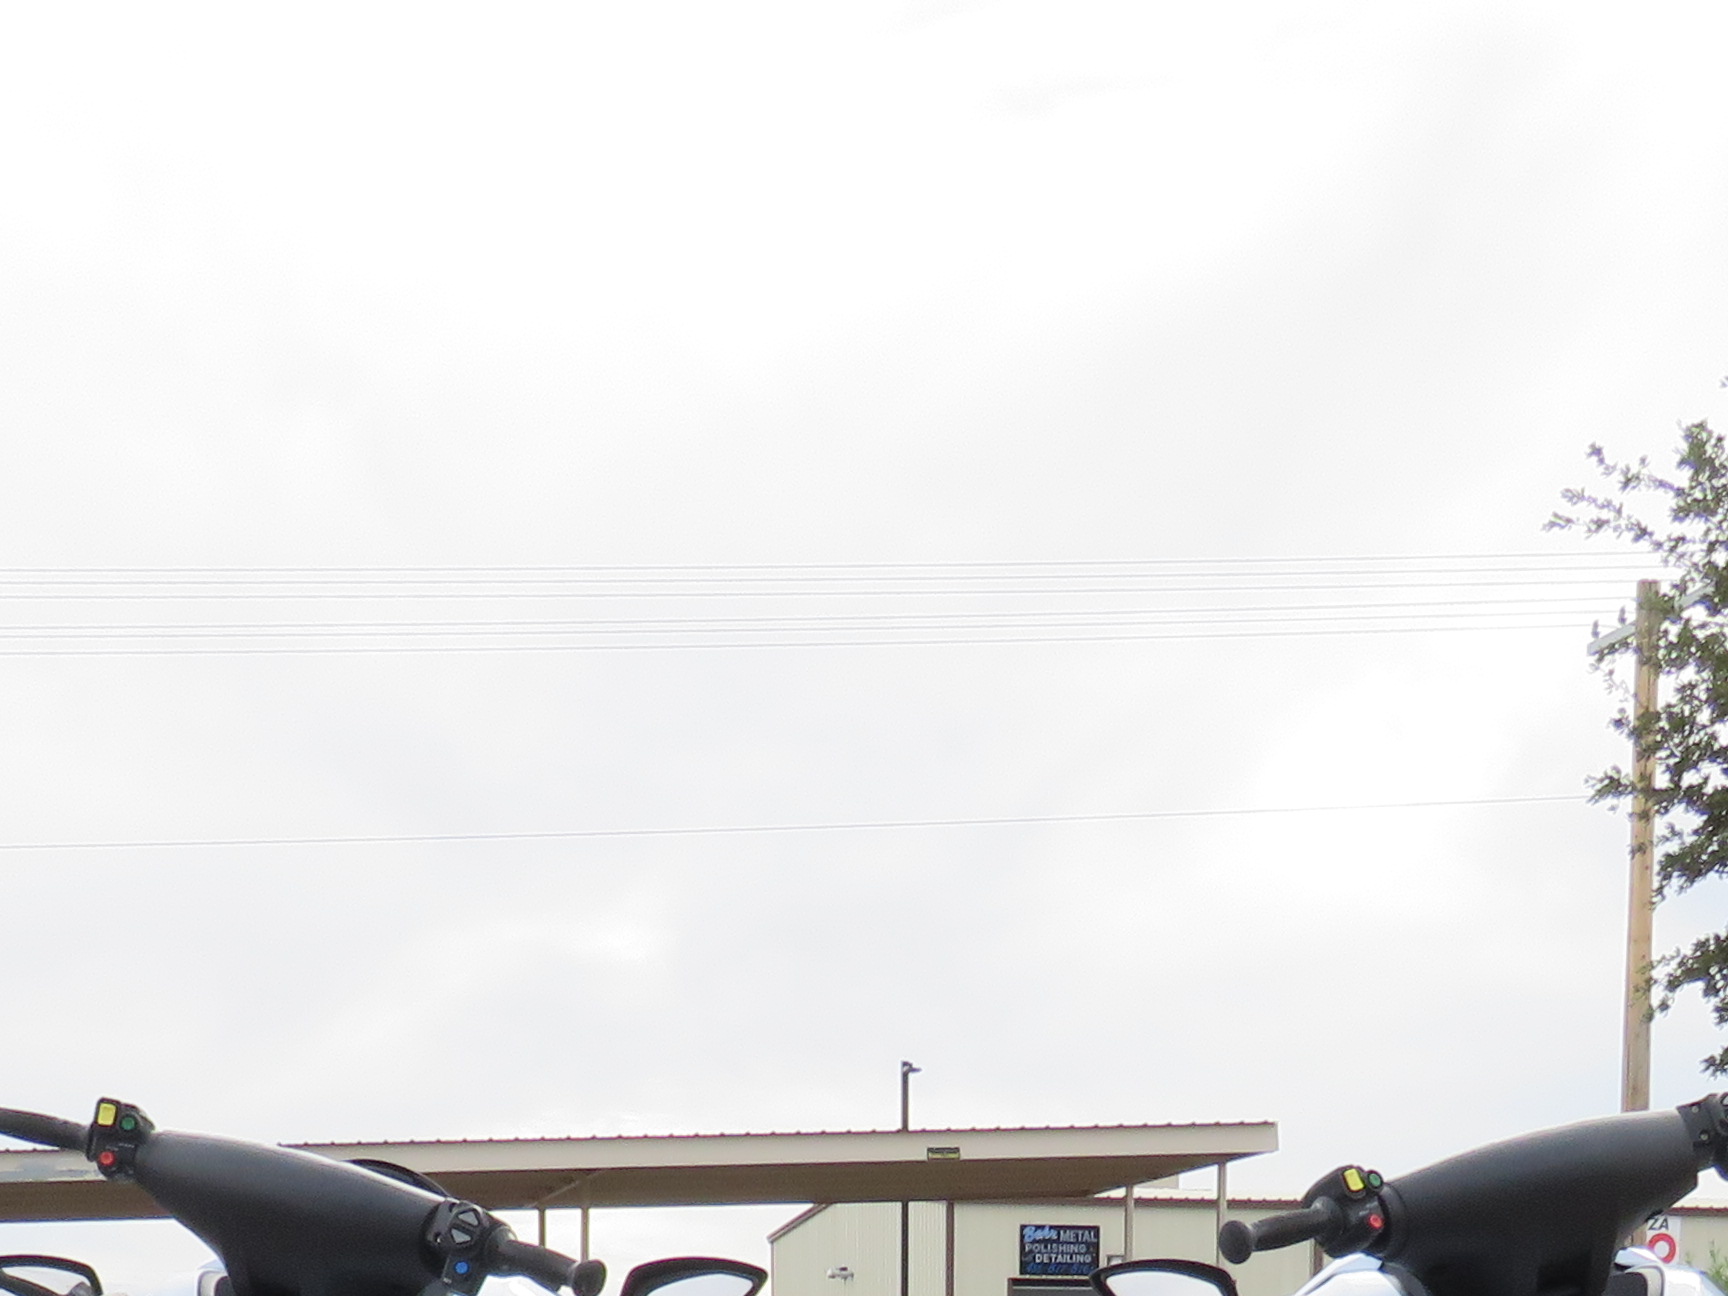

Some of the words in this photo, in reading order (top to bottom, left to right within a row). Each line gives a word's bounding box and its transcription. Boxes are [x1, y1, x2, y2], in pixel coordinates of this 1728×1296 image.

[1059, 1229, 1098, 1242] METAL
[1025, 1243, 1087, 1253] POLISHING
[1035, 1253, 1092, 1263] DETAILING
